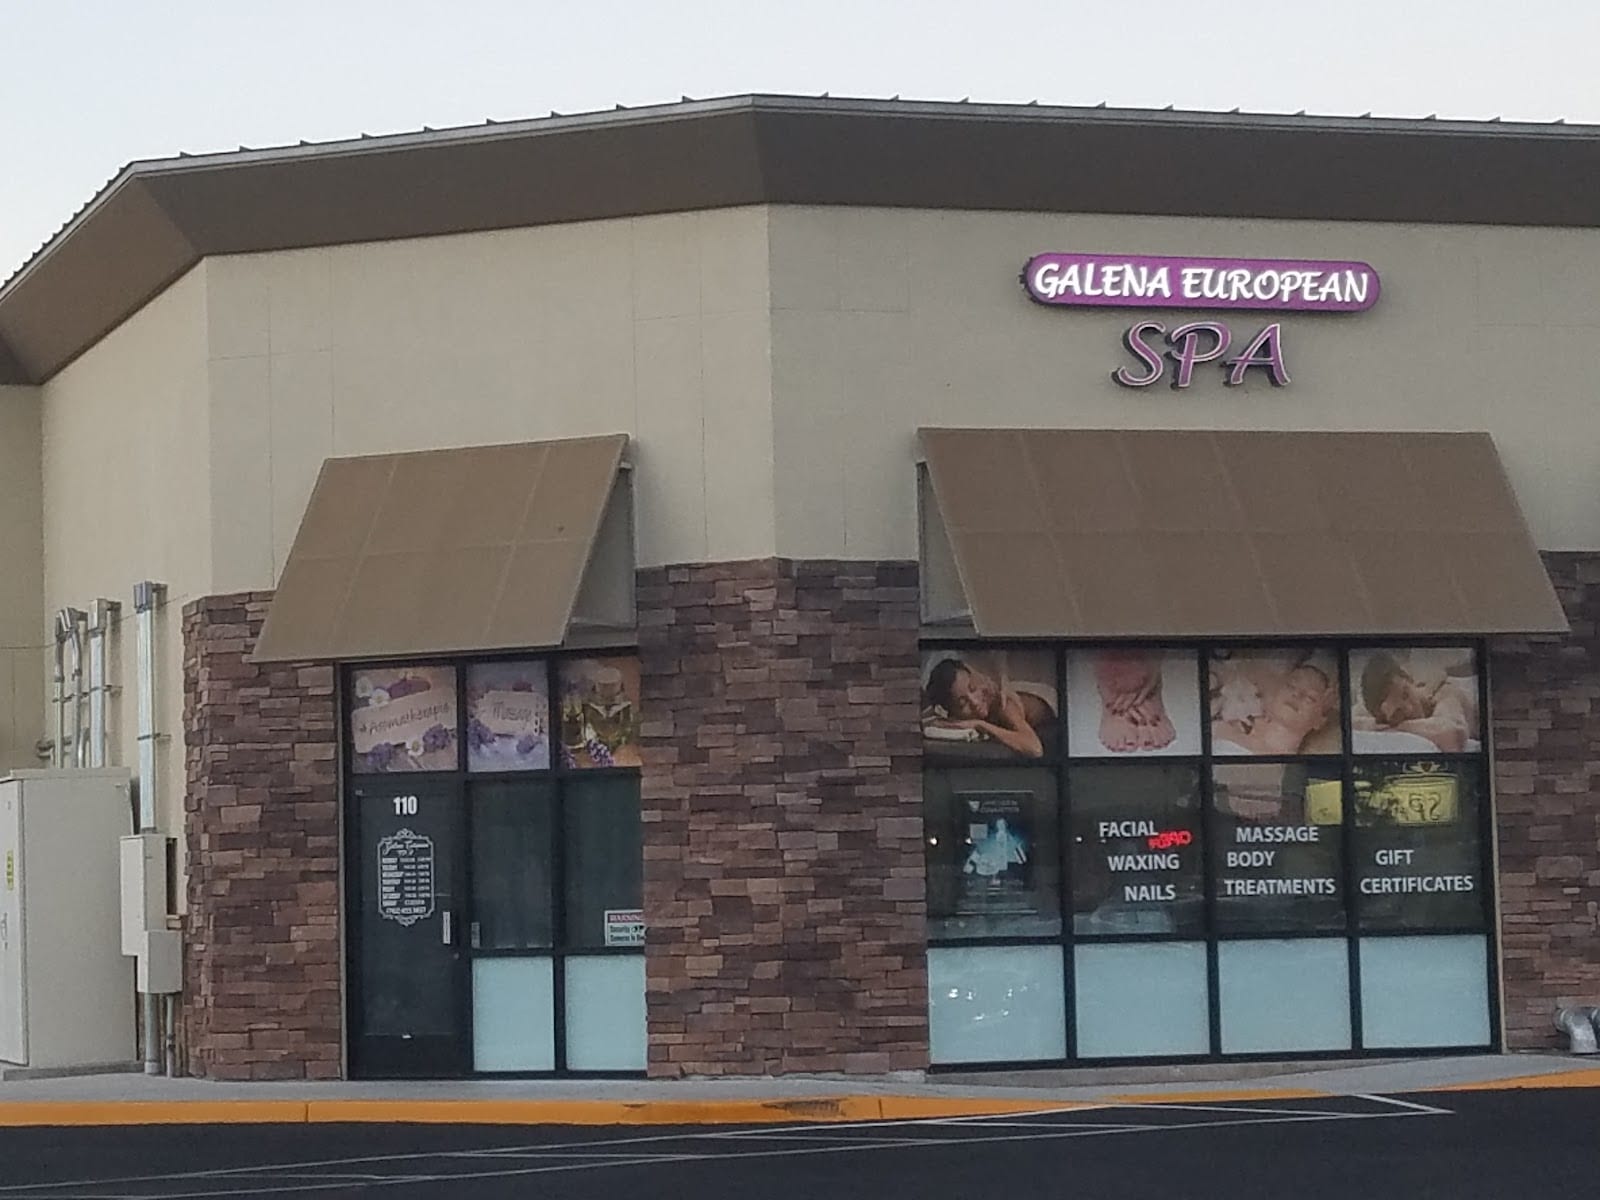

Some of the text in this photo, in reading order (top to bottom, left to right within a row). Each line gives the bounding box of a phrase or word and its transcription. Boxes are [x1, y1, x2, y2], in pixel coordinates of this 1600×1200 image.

[1035, 263, 1367, 302] GALENA EUROPEAN
[1116, 320, 1291, 388] SPA
[393, 796, 418, 815] 110
[1099, 820, 1159, 837] FACIAL
[1236, 826, 1319, 843] MASSAGE
[1108, 853, 1180, 871] WAXING
[1227, 851, 1275, 867] BODY
[1375, 849, 1414, 866] GIFT
[1124, 884, 1176, 902] NAILS
[1224, 878, 1336, 895] TREATMENTS
[1360, 875, 1474, 894] CERTIFICATES
